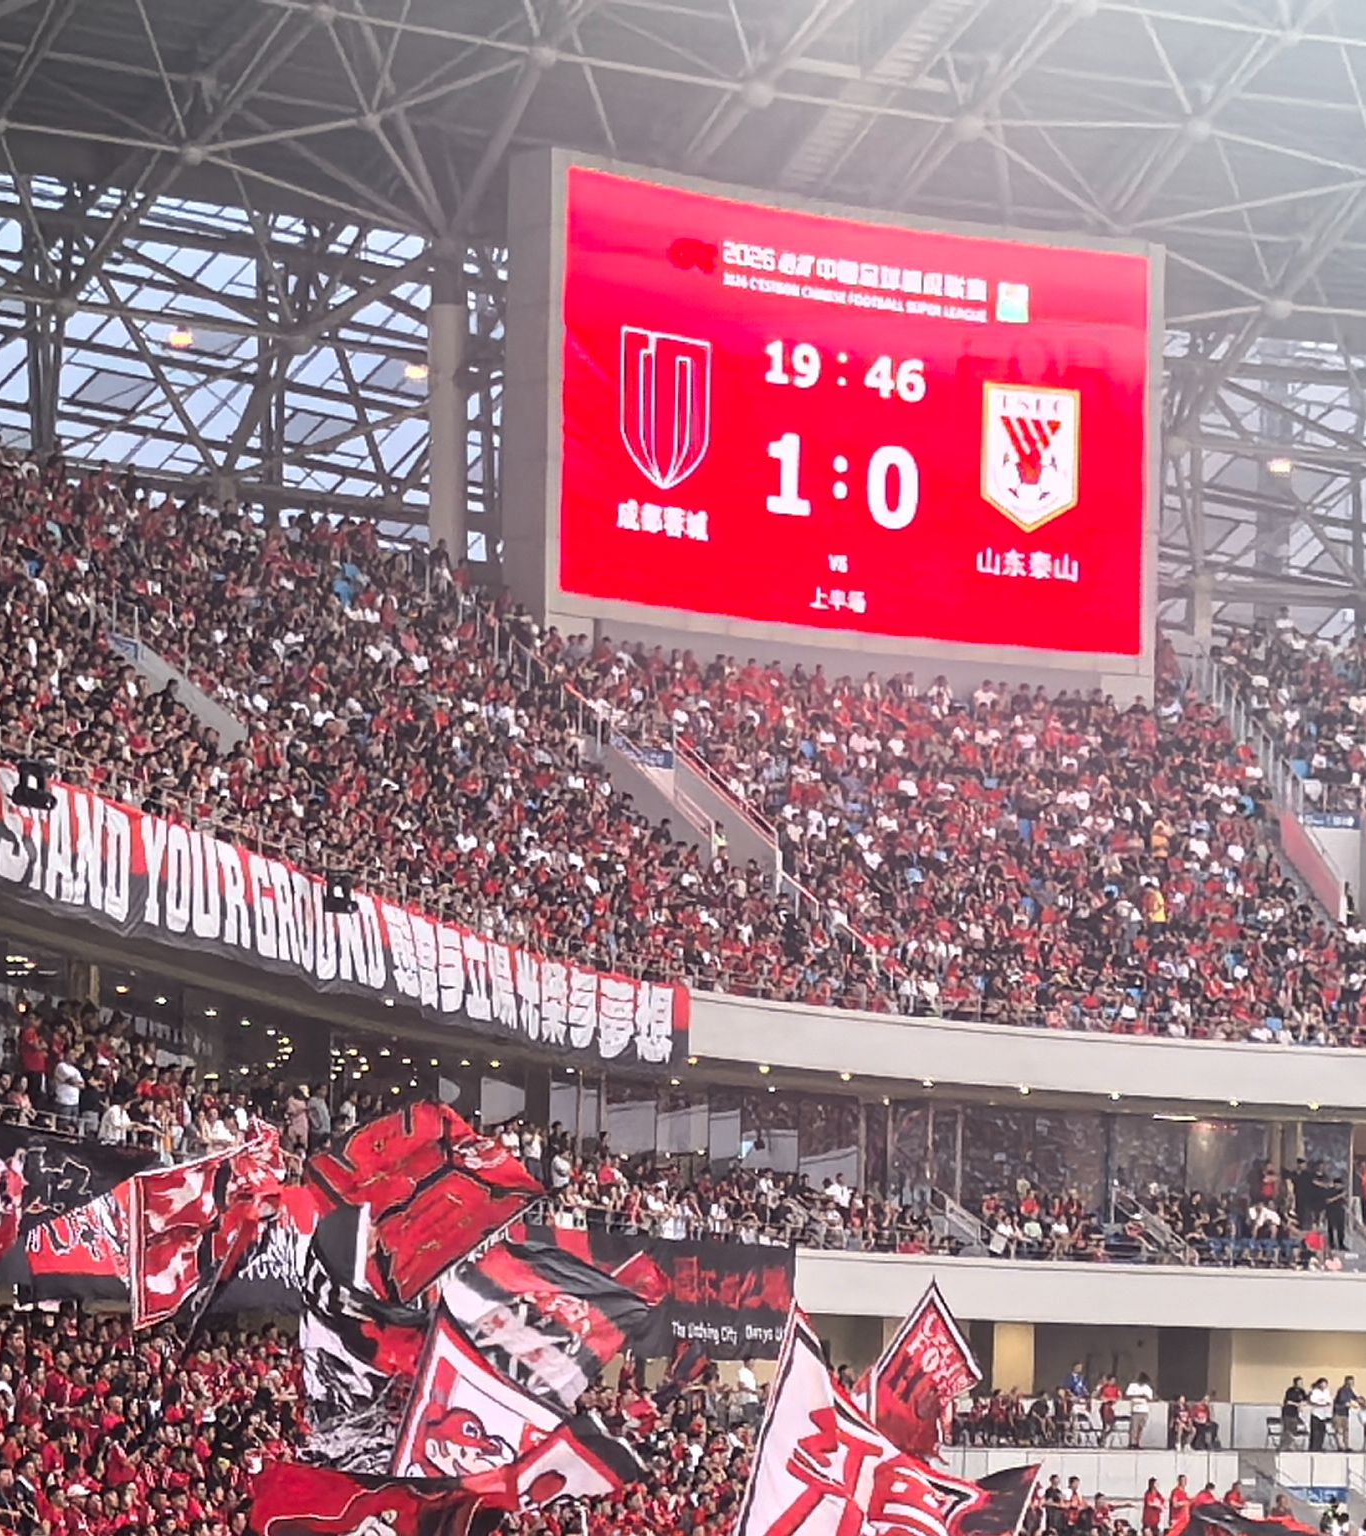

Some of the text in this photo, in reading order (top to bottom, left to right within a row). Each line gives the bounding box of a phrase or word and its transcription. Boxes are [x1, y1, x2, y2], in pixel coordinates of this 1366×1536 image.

[976, 547, 1080, 582] 山东泰山
[141, 814, 252, 950] YOUR
[249, 855, 388, 990] GROUND
